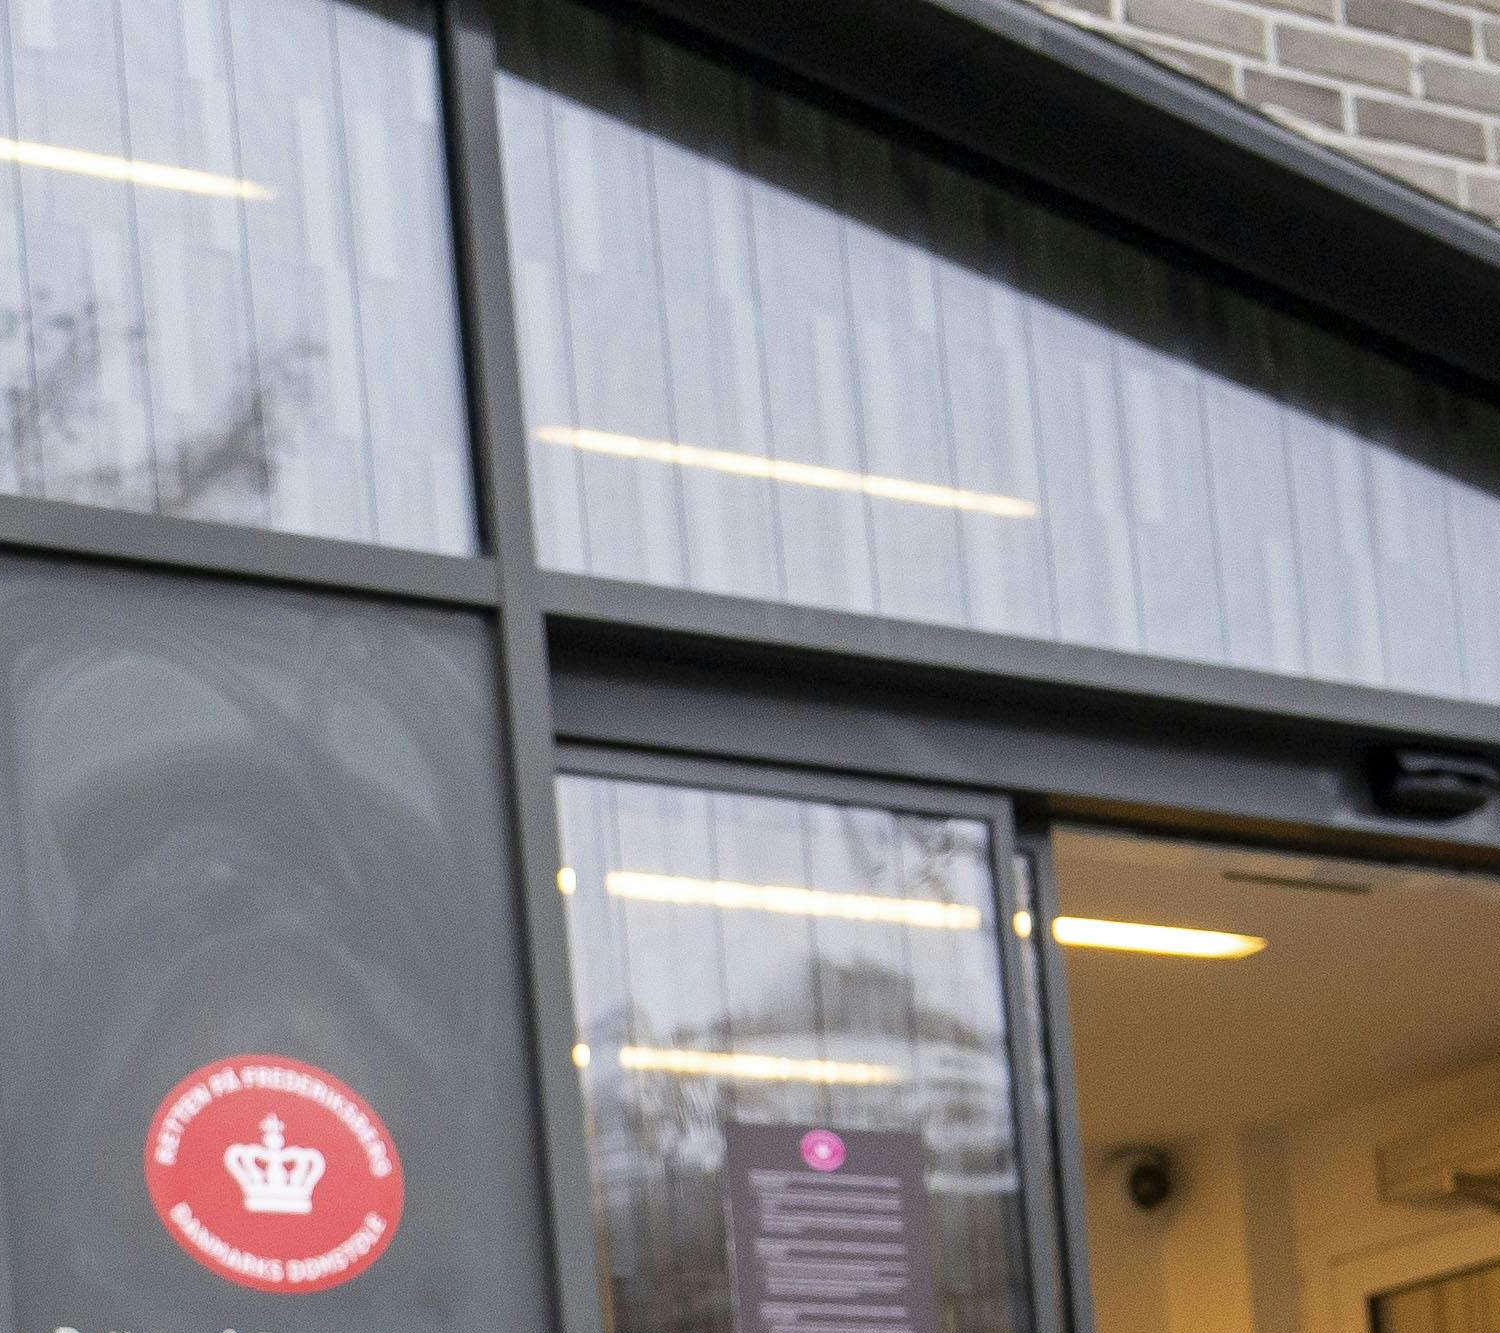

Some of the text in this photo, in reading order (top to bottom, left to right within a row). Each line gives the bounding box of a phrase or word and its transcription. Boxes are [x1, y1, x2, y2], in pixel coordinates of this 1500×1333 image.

[153, 1082, 212, 1166] RETTEN
[239, 1065, 393, 1178] FREDERIKSBERG
[169, 1201, 285, 1283] DANMARKS
